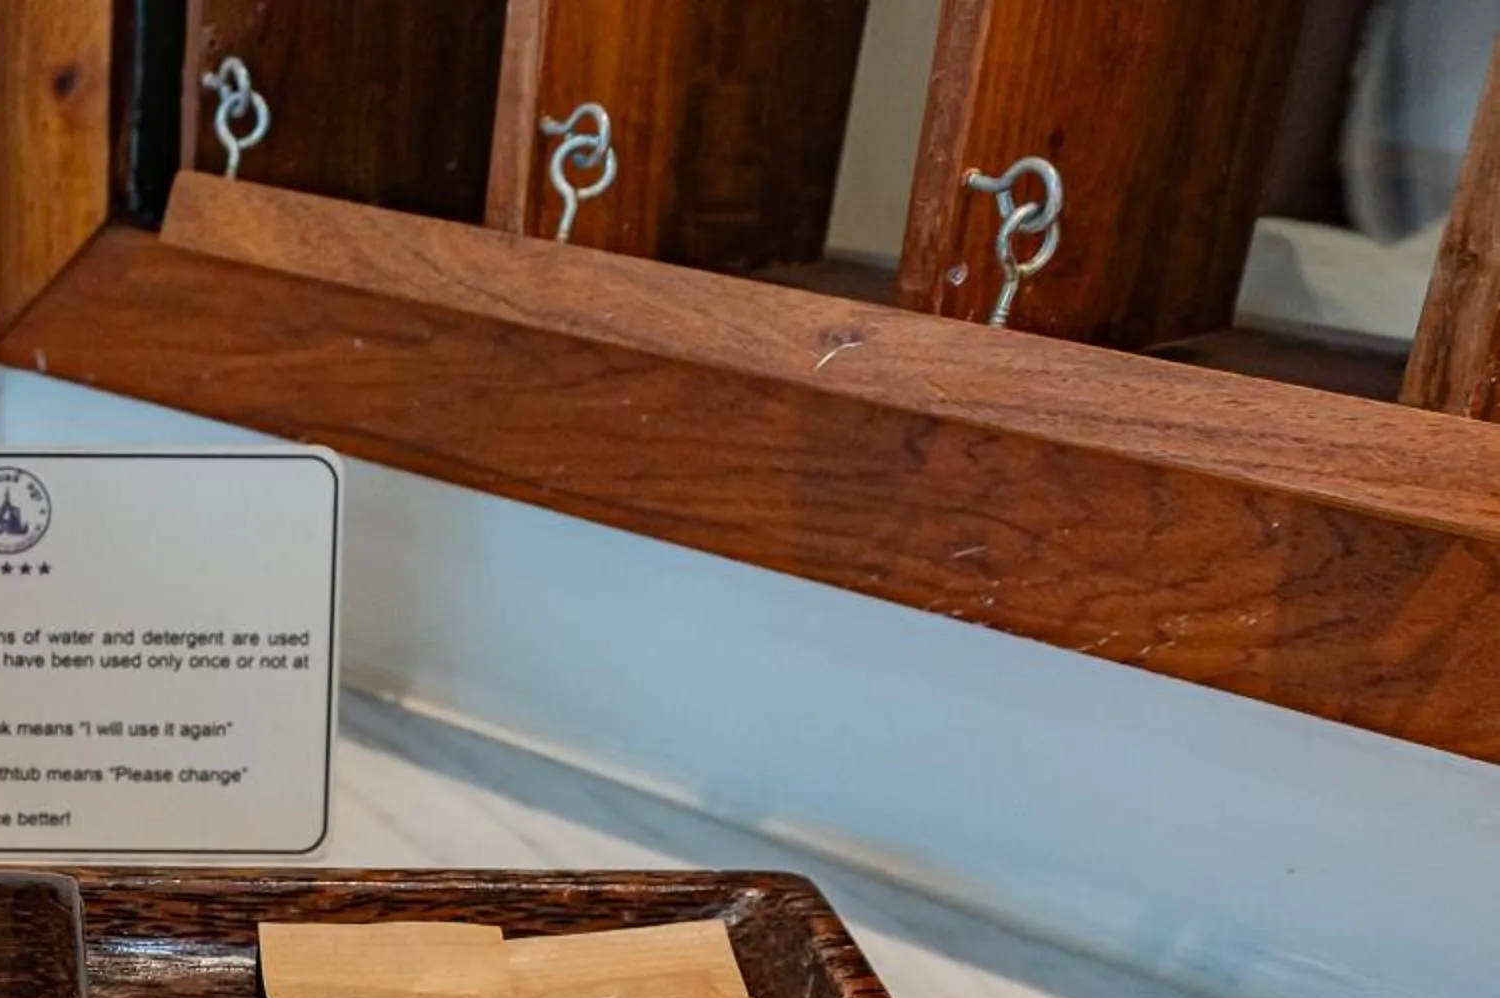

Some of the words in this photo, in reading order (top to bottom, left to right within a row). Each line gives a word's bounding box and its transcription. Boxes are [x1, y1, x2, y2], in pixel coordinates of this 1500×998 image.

[21, 627, 42, 646] of
[46, 629, 96, 647] water
[100, 628, 136, 647] and
[141, 629, 226, 651] detergent
[230, 631, 261, 648] are
[266, 629, 311, 648] used
[2, 651, 46, 670] have
[50, 651, 95, 670] been
[99, 651, 142, 670] used
[146, 652, 184, 673] only
[188, 654, 231, 671] once
[235, 655, 255, 670] or
[259, 653, 288, 671] not
[292, 653, 310, 671] at
[16, 722, 74, 738] means
[96, 720, 123, 737] will
[128, 723, 160, 738] use
[164, 721, 175, 738] it
[45, 768, 104, 783] means
[17, 810, 71, 828] better!
